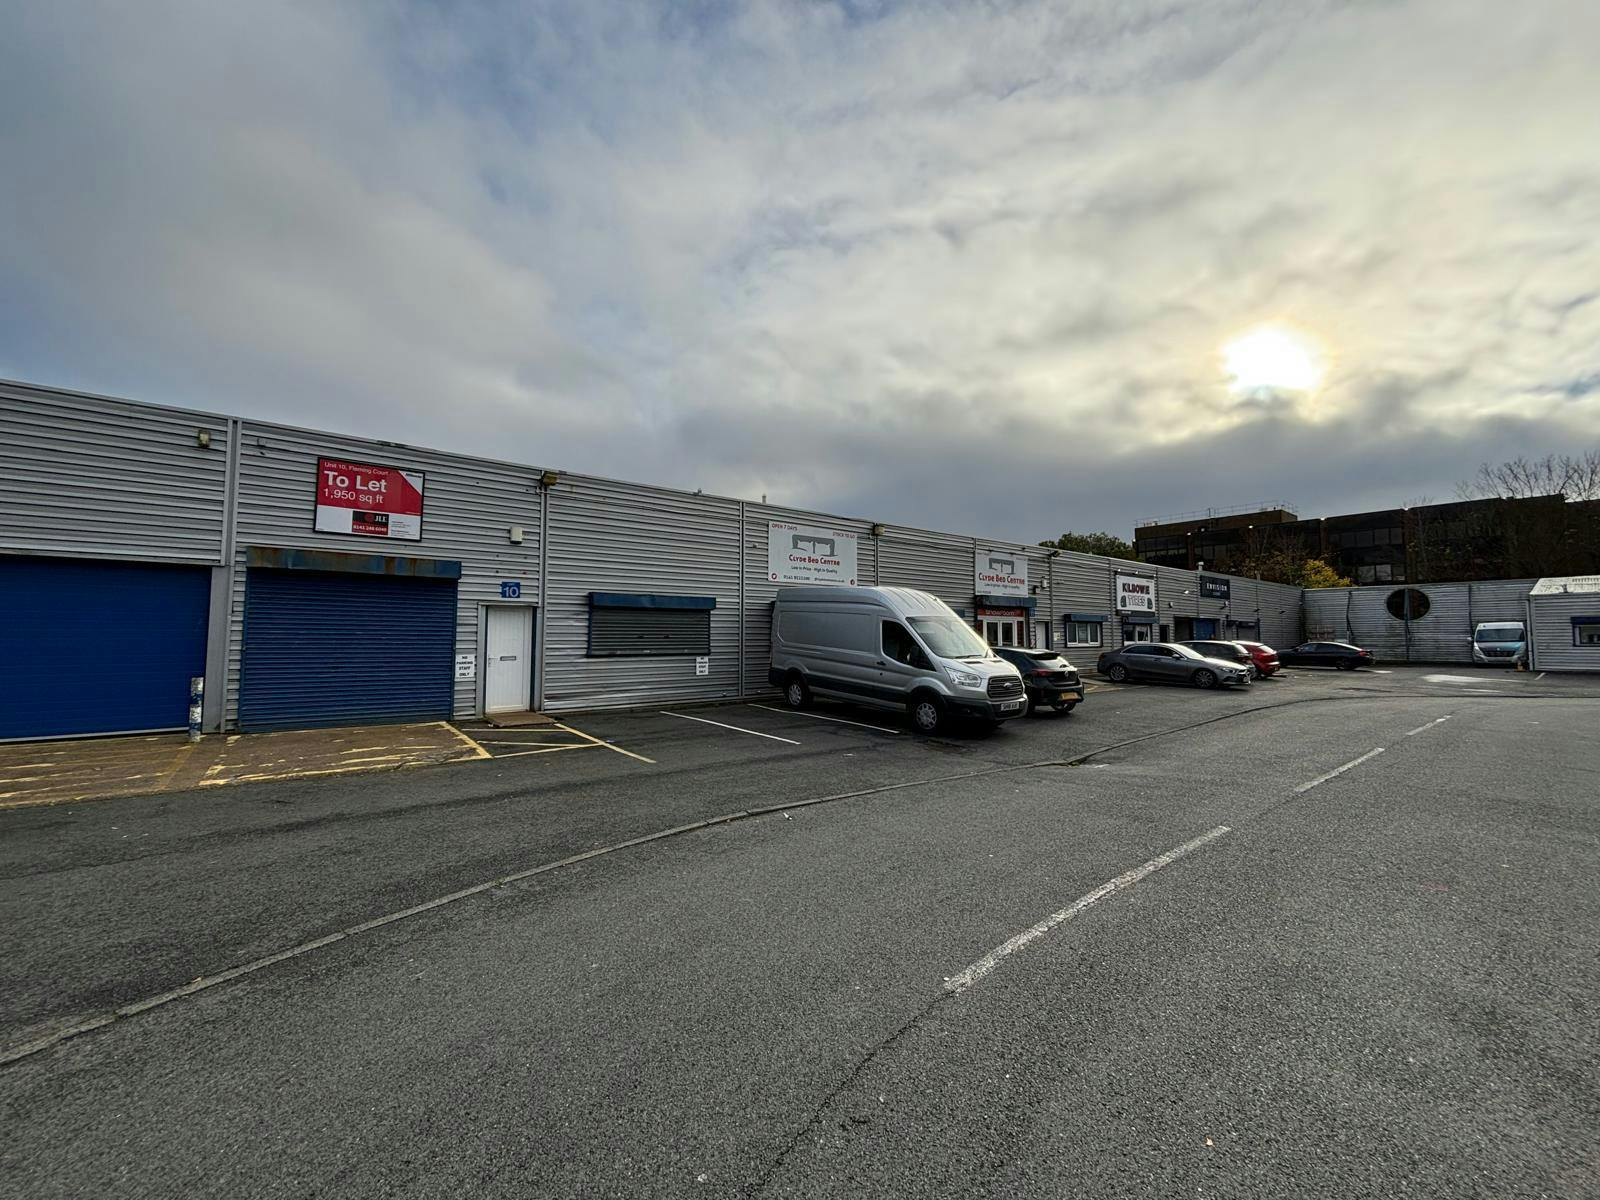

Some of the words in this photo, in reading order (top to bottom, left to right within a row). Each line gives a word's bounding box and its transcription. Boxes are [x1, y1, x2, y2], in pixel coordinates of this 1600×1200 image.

[349, 466, 372, 474] Fleming
[324, 470, 349, 488] To
[356, 475, 387, 492] Let
[324, 488, 356, 500] 1,950
[359, 494, 372, 504] sq
[376, 494, 383, 504] ft
[503, 586, 519, 597] 10
[1128, 595, 1145, 606] TYRES
